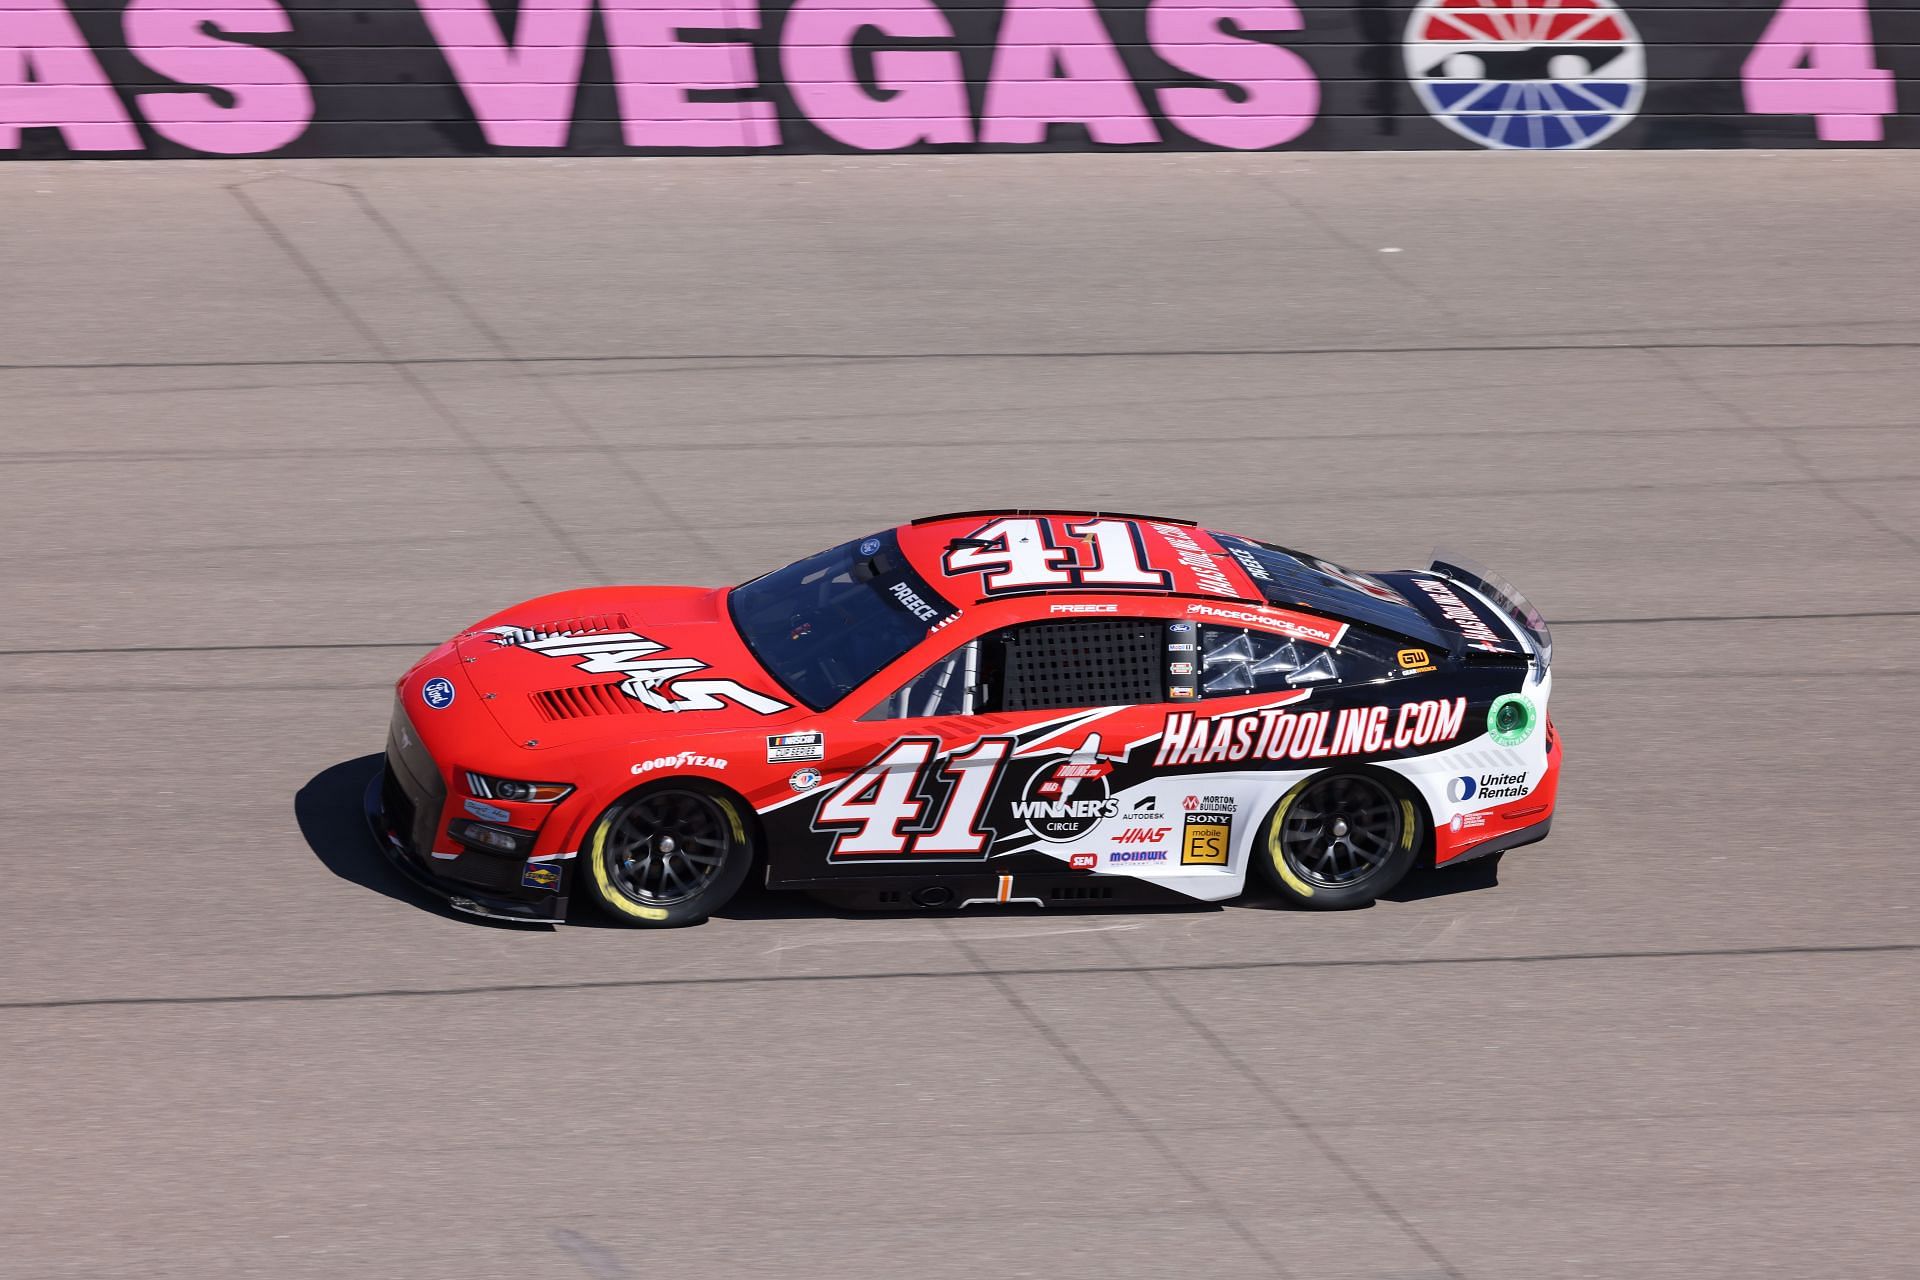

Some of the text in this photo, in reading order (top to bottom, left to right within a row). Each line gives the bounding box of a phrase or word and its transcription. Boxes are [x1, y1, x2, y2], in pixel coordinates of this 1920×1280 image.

[418, 0, 1320, 151] VEGAS
[1740, 0, 1898, 141] 4
[943, 517, 1172, 595] 41
[889, 582, 938, 622] PREECE
[1050, 604, 1118, 613] PREECE
[1200, 605, 1331, 640] RACECHOICE.COM
[425, 681, 450, 704] Ford
[1153, 698, 1467, 766] HAASTOOLING.COM
[1480, 771, 1527, 787] United
[812, 737, 1017, 861] 41
[1478, 784, 1529, 799] Rentals
[1200, 803, 1237, 812] BUILDINGS
[1202, 796, 1235, 804] MORTON
[1011, 798, 1119, 819] WINNER'S
[1186, 814, 1230, 823] SONY
[1046, 822, 1079, 832] CIRCLE
[1110, 827, 1173, 843] HAAS
[1192, 829, 1221, 837] mobile
[1191, 837, 1220, 857] ES
[1072, 856, 1094, 867] SEM
[1109, 851, 1168, 863] MOHAWK
